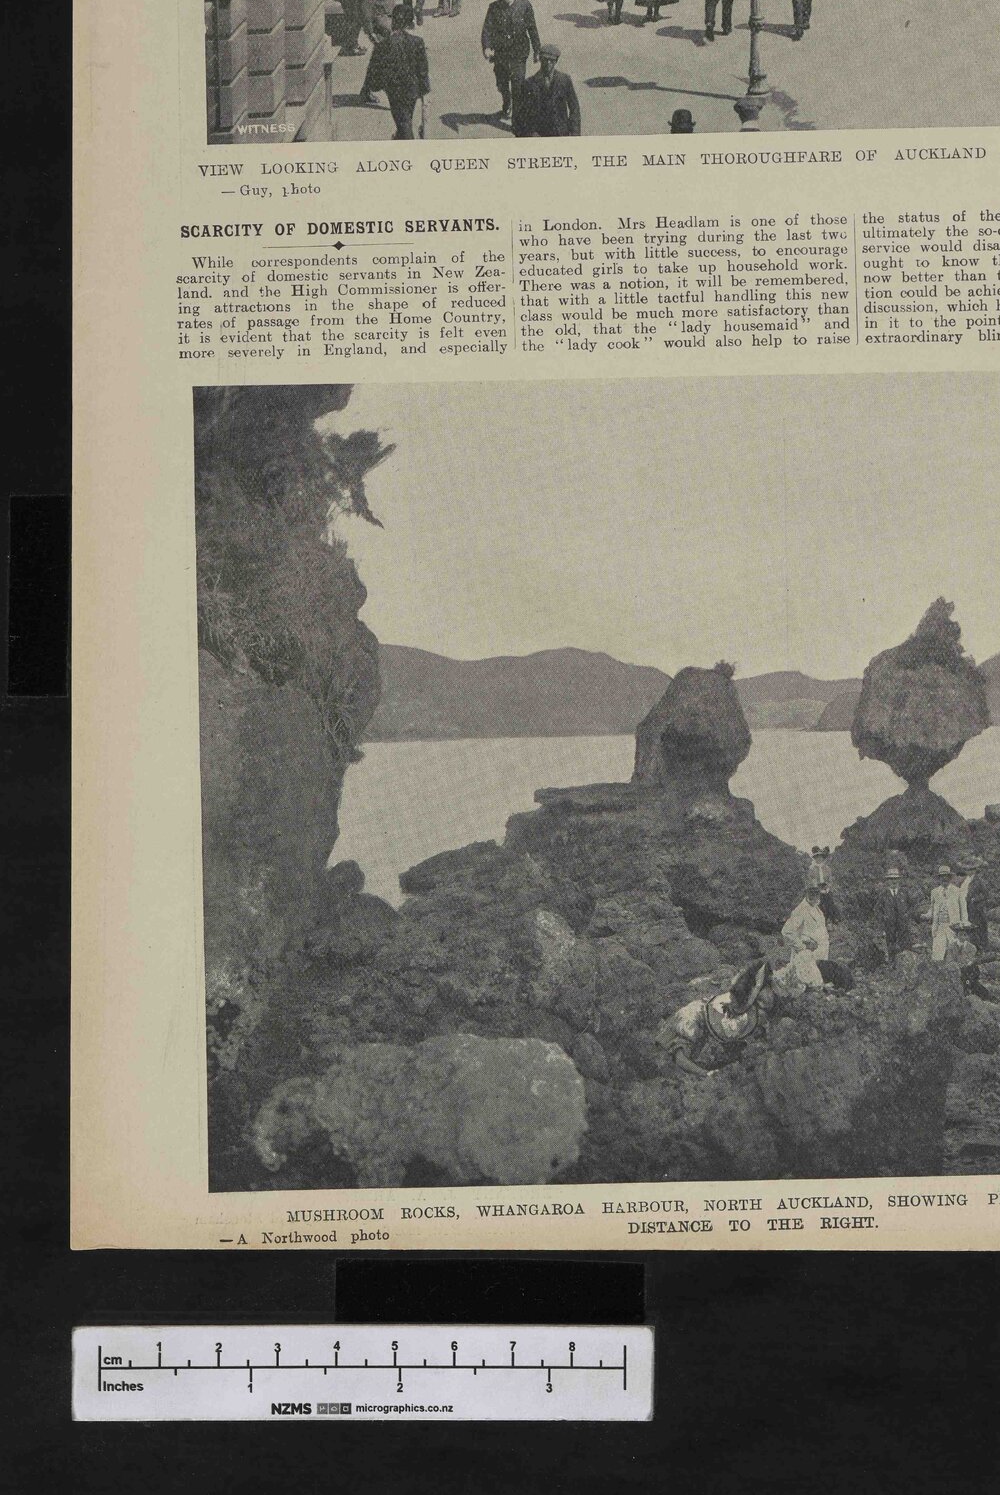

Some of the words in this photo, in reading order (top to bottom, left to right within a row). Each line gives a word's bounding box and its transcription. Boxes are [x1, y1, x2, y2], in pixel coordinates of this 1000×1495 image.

[237, 123, 296, 135] WITNESS
[197, 163, 244, 177] VIEW
[260, 161, 339, 175] LOOKING
[355, 159, 413, 173] ALONG
[429, 157, 491, 174] QUEEN
[507, 156, 578, 171] STREET,
[591, 154, 628, 168] THE
[641, 153, 687, 167] MAIN
[700, 150, 843, 166] THOROUGHFARE
[855, 149, 878, 162] OF
[893, 147, 987, 161] AUCKLAND
[180, 223, 264, 239] SCARCITY
[274, 222, 296, 237] OF
[306, 220, 394, 236] DOMESTIC
[404, 217, 500, 234] SERVANTS.
[862, 225, 936, 241] ultimately
[945, 224, 969, 238] the
[518, 252, 560, 265] years,
[570, 248, 595, 261] but
[603, 246, 636, 260] with
[644, 245, 679, 259] little
[687, 248, 741, 259] success,
[751, 245, 767, 257] to
[775, 246, 849, 258] encourage
[861, 240, 911, 254] service
[919, 239, 963, 253] would
[191, 255, 234, 270] While
[251, 253, 358, 270] correspondents
[371, 251, 437, 268] complain
[451, 250, 466, 264] of
[482, 249, 506, 263] the
[175, 272, 231, 287] scarcity
[240, 270, 256, 283] of
[266, 269, 329, 283] domestic
[338, 268, 397, 281] servants
[407, 266, 422, 280] in
[431, 265, 465, 279] New
[474, 265, 506, 278] Zea-
[520, 293, 550, 308] that
[558, 292, 590, 306] with
[597, 296, 607, 305] a
[613, 291, 649, 305] little
[657, 290, 705, 305] tactful
[713, 288, 777, 305] handling
[785, 287, 812, 301] this
[820, 290, 849, 300] new
[864, 329, 964, 345] extraordinary
[286, 1207, 385, 1224] MUSHROOM
[400, 1205, 460, 1221] ROCKS,
[475, 1202, 586, 1218] WHANGAROA
[601, 1199, 689, 1215] HARBOUR,
[703, 1198, 763, 1212] NORTH
[776, 1195, 873, 1211] AUCKLAND,
[887, 1193, 969, 1208] SHOWING
[627, 1219, 714, 1235] DISTANCE
[728, 1219, 751, 1233] TO
[766, 1217, 805, 1232] THE
[819, 1216, 879, 1230] RIGHT.
[260, 1229, 338, 1245] Northwood
[350, 1228, 390, 1245] photo
[156, 1341, 163, 1353] 1
[215, 1342, 222, 1354] 2
[274, 1342, 281, 1354] 3
[333, 1340, 341, 1352] 4
[391, 1340, 399, 1352] 5
[450, 1340, 458, 1352] 6
[509, 1340, 517, 1352] 7
[568, 1340, 576, 1352] 8
[103, 1356, 123, 1365] cm
[103, 1380, 145, 1392] Inches
[247, 1382, 254, 1394] 1
[396, 1382, 404, 1393] 2
[545, 1382, 553, 1394] 3
[271, 1402, 312, 1415] NZMS
[355, 1403, 454, 1416] micrographics.co.nz
